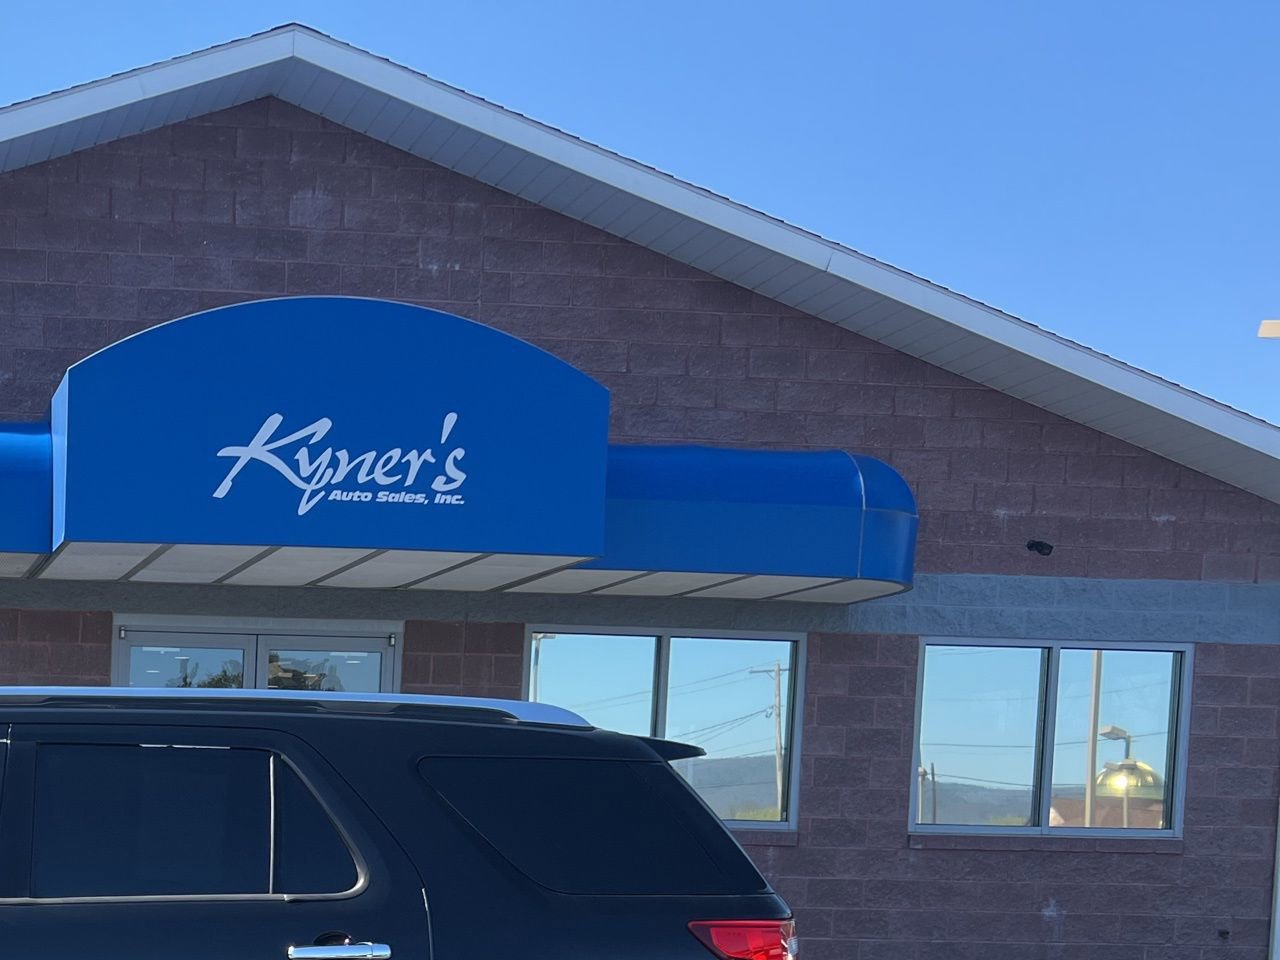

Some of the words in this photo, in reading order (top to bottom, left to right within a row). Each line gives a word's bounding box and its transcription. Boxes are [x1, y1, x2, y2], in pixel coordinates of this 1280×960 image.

[213, 412, 467, 515] Kyner's
[328, 489, 372, 502] Auto
[376, 490, 429, 505] Sales,
[434, 492, 465, 505] Inc.
